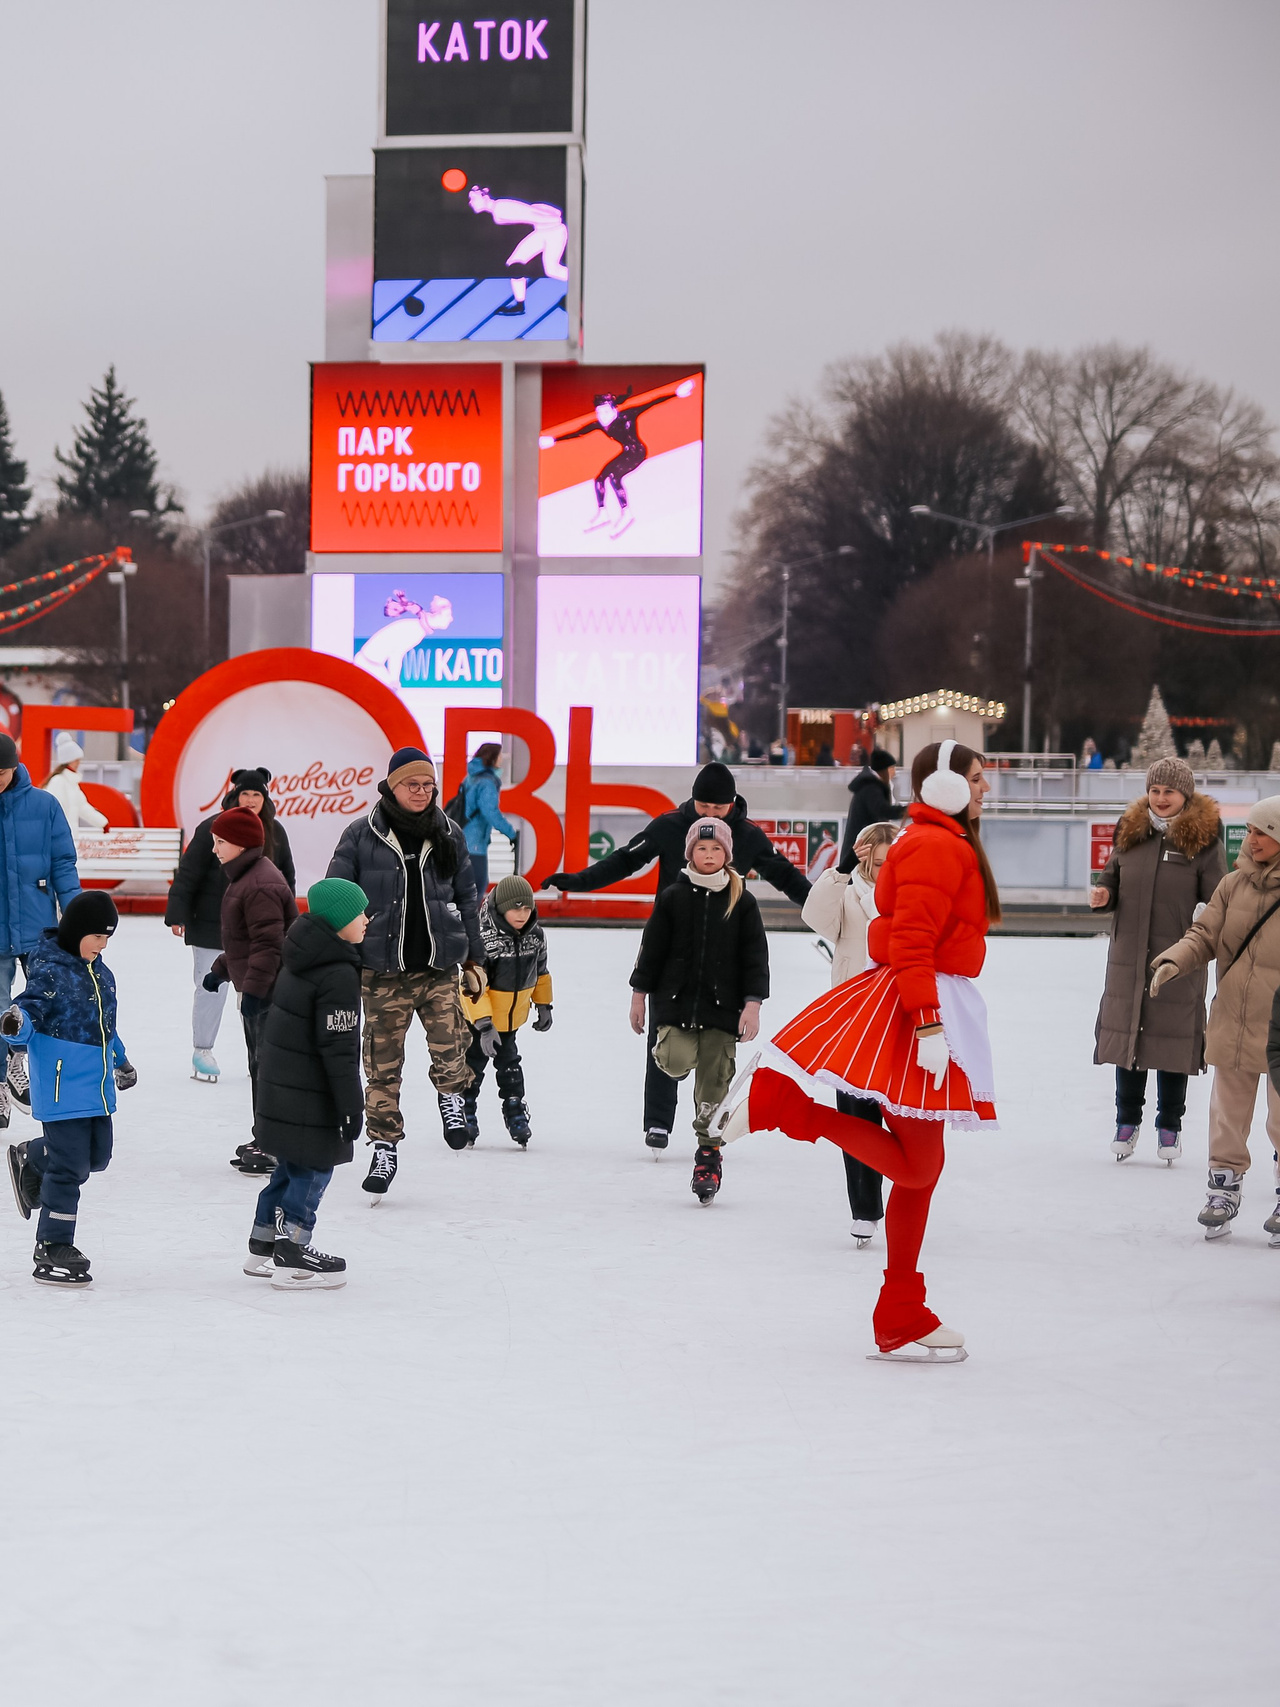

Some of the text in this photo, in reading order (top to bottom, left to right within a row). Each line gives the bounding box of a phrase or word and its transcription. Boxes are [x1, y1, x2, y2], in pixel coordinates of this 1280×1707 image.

[418, 18, 549, 62] КАТОК
[337, 426, 413, 456] ПАРК
[337, 461, 481, 492] ГОРЬКОГО
[434, 648, 503, 681] КАТО
[555, 651, 688, 695] КАТОК
[199, 760, 374, 812] ковское
[272, 789, 368, 819] питие
